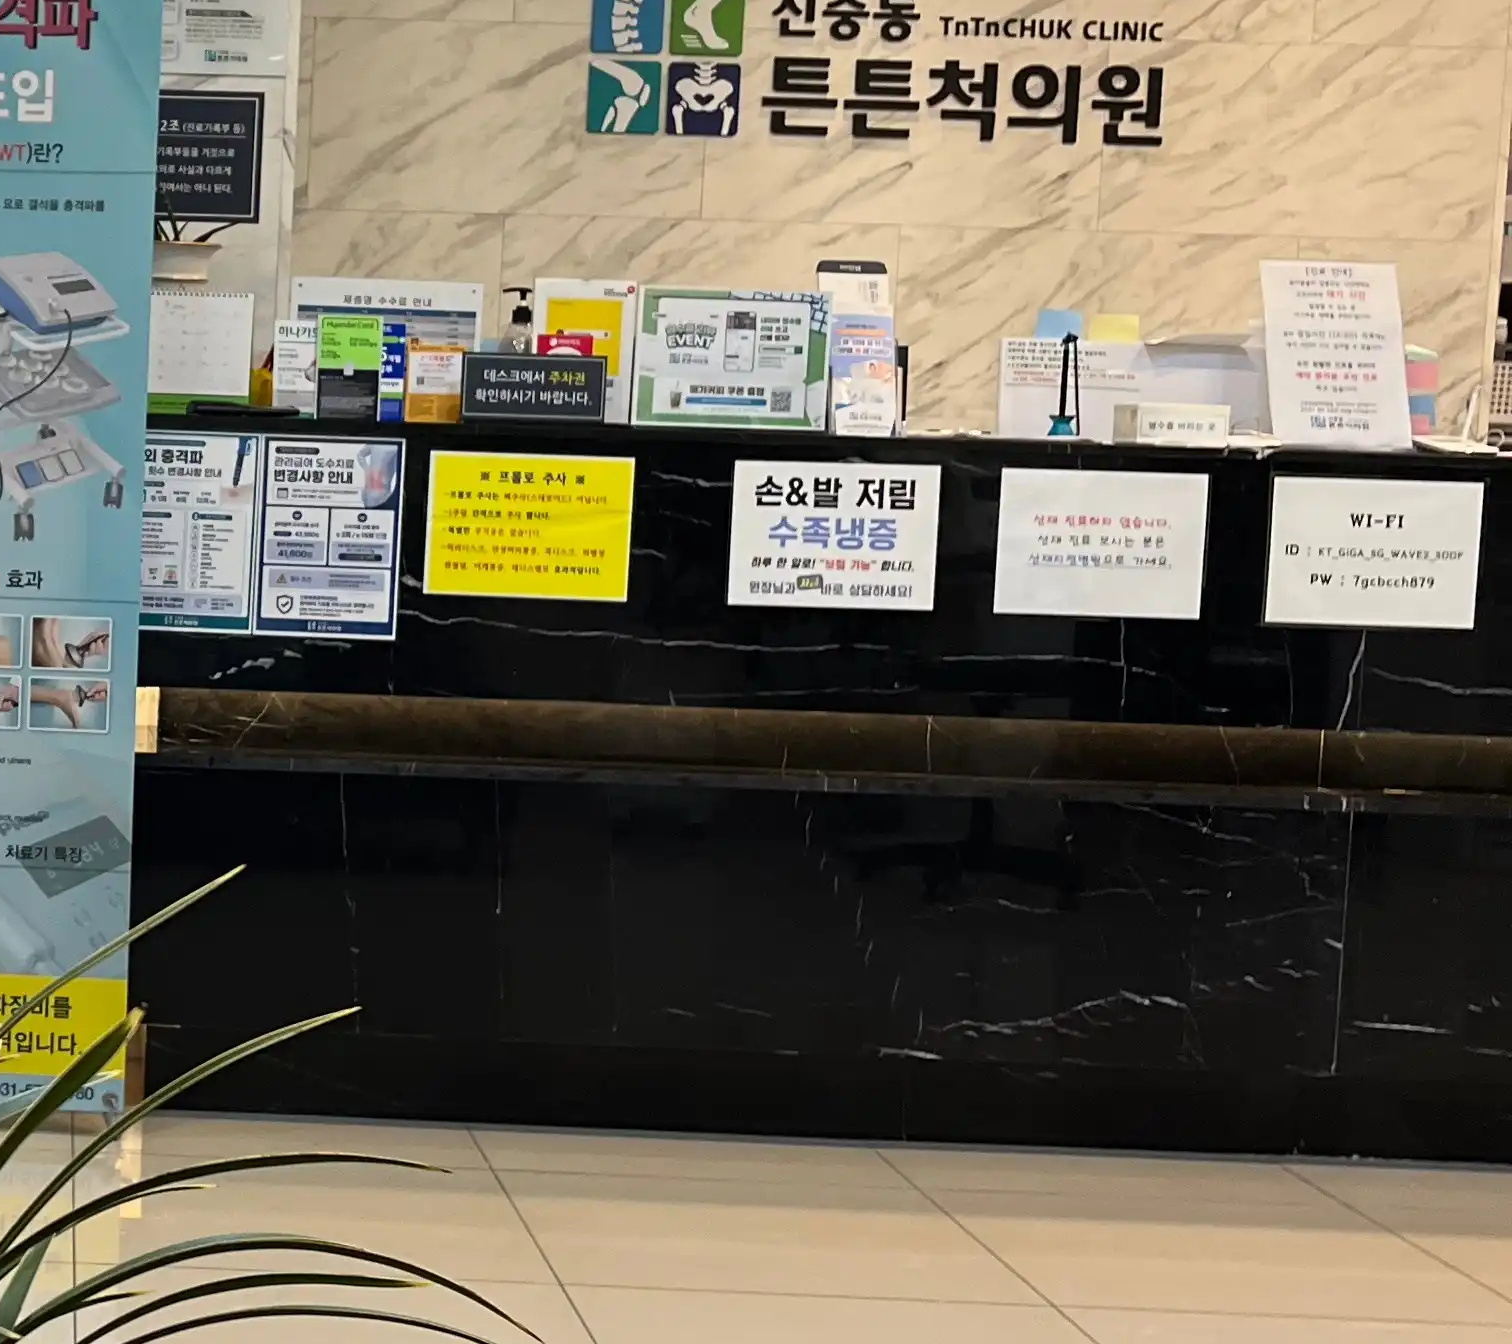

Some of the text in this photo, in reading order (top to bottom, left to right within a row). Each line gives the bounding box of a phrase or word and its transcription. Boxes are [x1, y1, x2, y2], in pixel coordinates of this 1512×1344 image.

[940, 16, 1072, 41] TnTnCHUK
[1083, 19, 1164, 43] CLINIC
[762, 55, 1166, 148] 튼튼척의원
[667, 334, 713, 350] EVENT
[483, 368, 586, 386] 데스크에서 주차권
[475, 389, 593, 406] 확인하시기 바랍니다.
[161, 449, 203, 465] 충격파
[316, 458, 354, 470] 도수치료
[204, 468, 222, 478] 안내
[274, 469, 353, 485] 변경사항 안내
[543, 472, 566, 486] 주사
[754, 474, 916, 510] 손&발 저림
[1350, 513, 1404, 529] WI-FI
[768, 517, 897, 552] 수족냉증
[1101, 536, 1135, 547] 보시는
[1286, 544, 1299, 556] ID
[751, 556, 787, 569] 하루 한
[6, 569, 43, 590] 효과
[1311, 574, 1332, 585] PW
[749, 580, 912, 599] 원장님과 상담하세요!
[5, 845, 48, 861] 치료기
[54, 846, 82, 863] 특징
